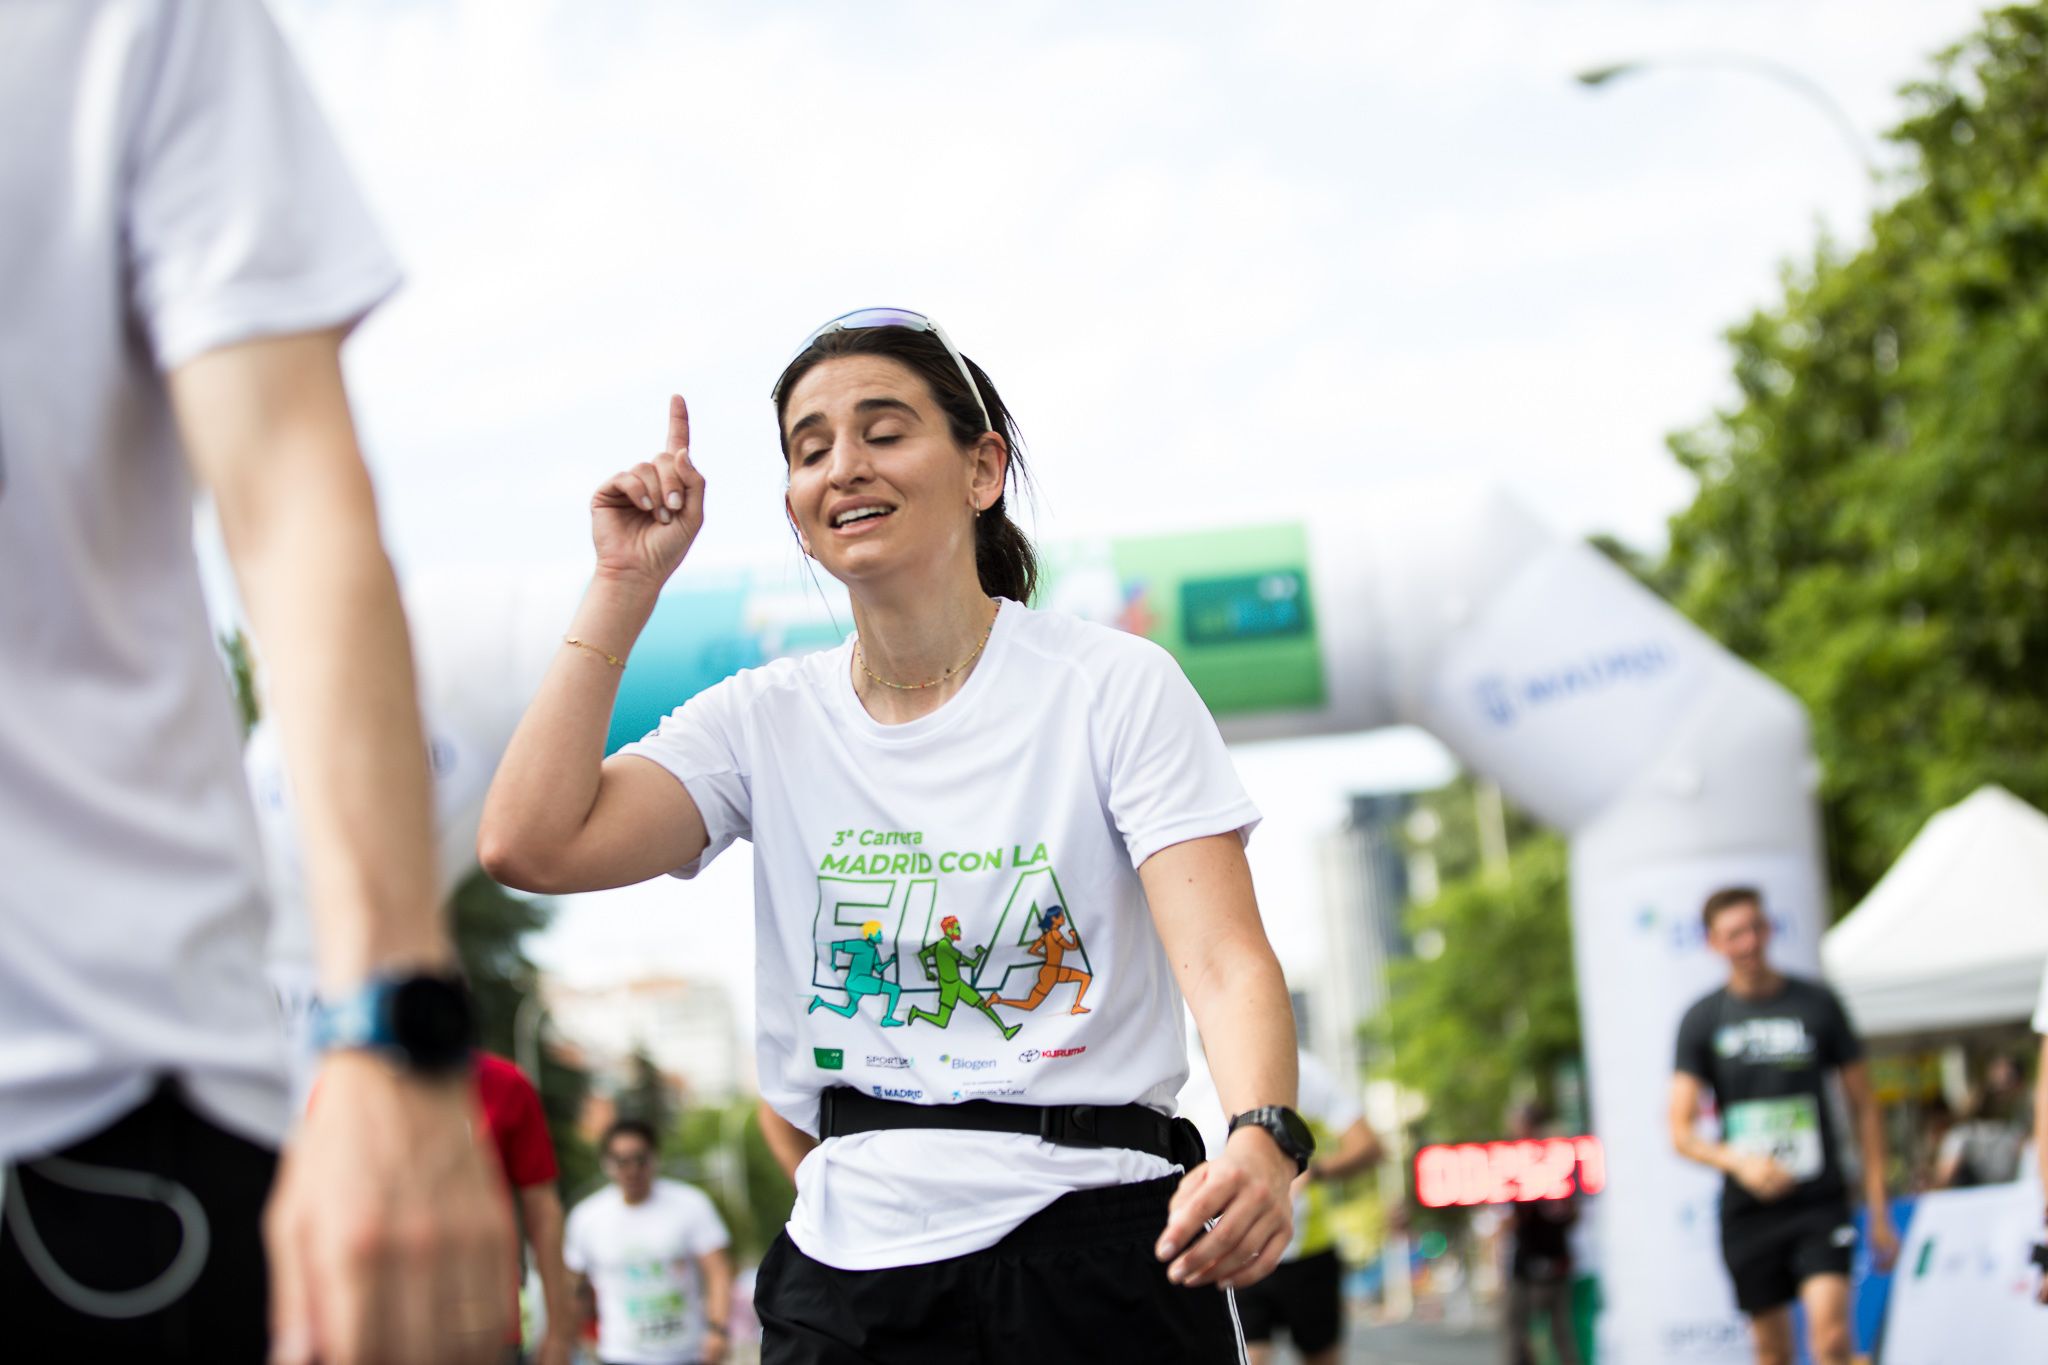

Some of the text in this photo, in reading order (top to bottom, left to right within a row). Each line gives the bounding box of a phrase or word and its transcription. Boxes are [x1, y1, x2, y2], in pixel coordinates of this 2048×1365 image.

[820, 842, 1048, 875] MADRID CON LA
[812, 866, 1094, 993] ELA
[951, 1057, 997, 1071] Biogen
[884, 1088, 923, 1100] MADRID
